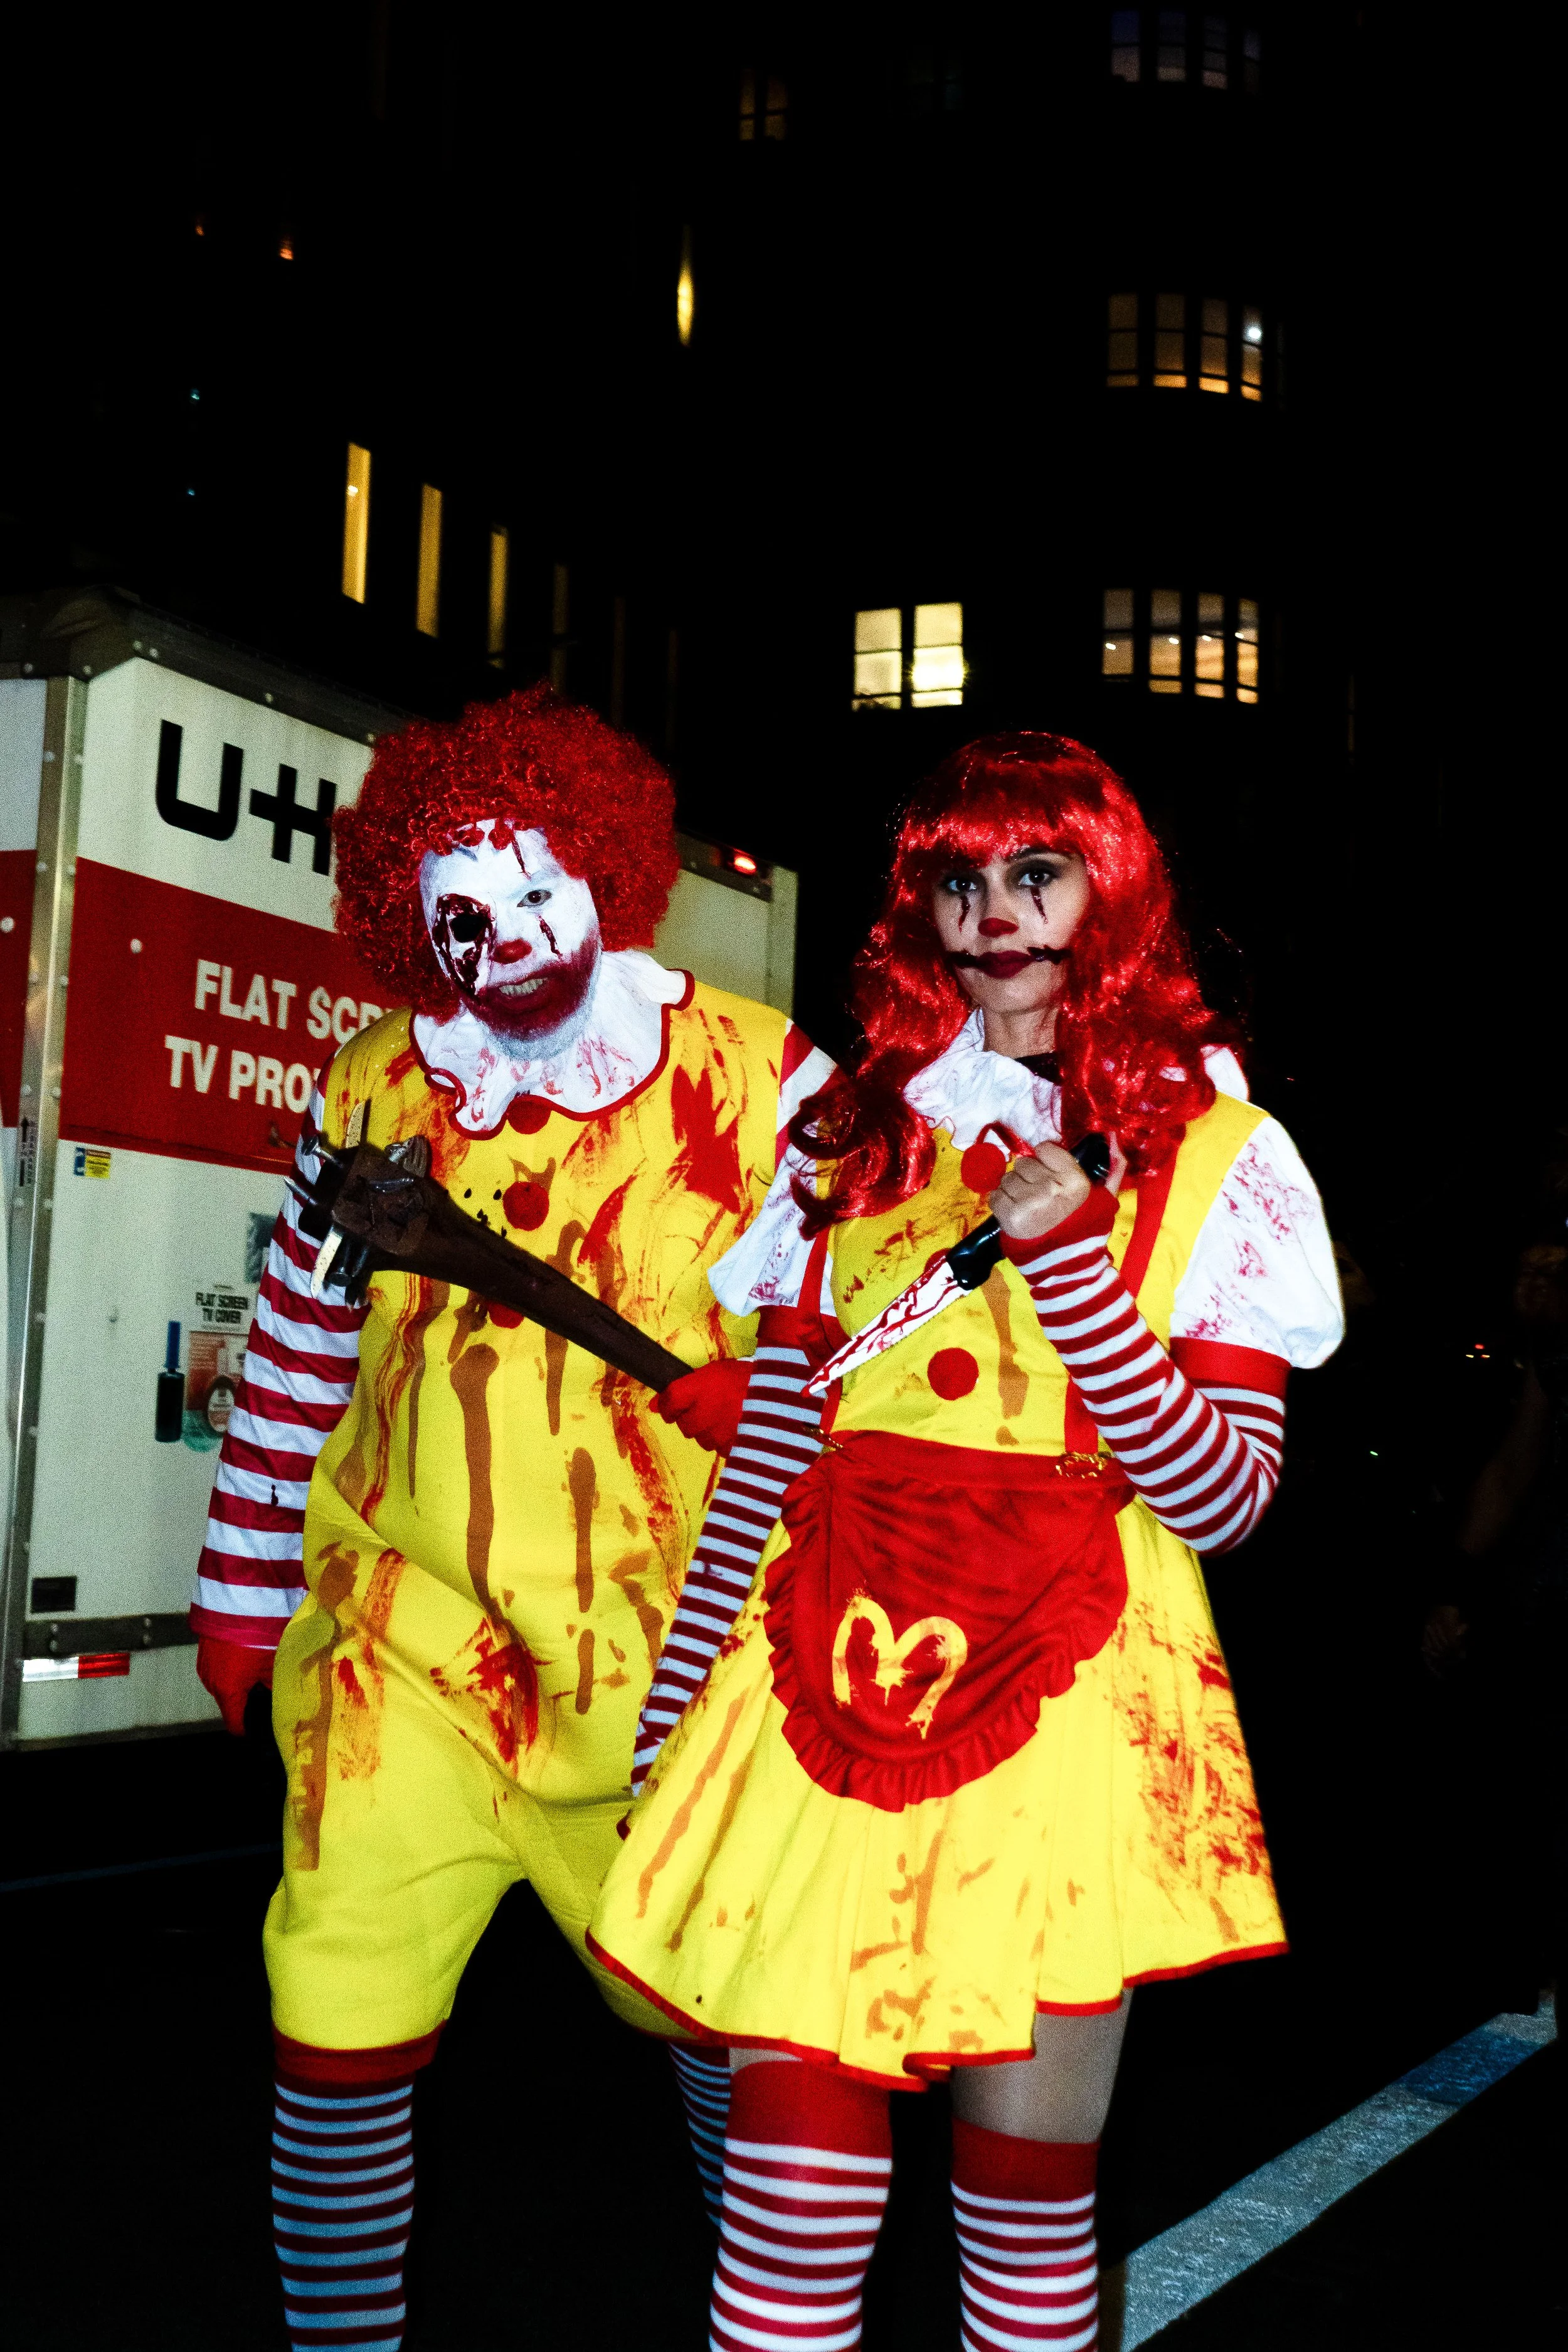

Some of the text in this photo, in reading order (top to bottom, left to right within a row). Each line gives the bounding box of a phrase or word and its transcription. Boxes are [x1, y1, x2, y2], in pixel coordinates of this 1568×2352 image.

[195, 959, 297, 1030] FLAT
[165, 1035, 321, 1113] TV PRO
